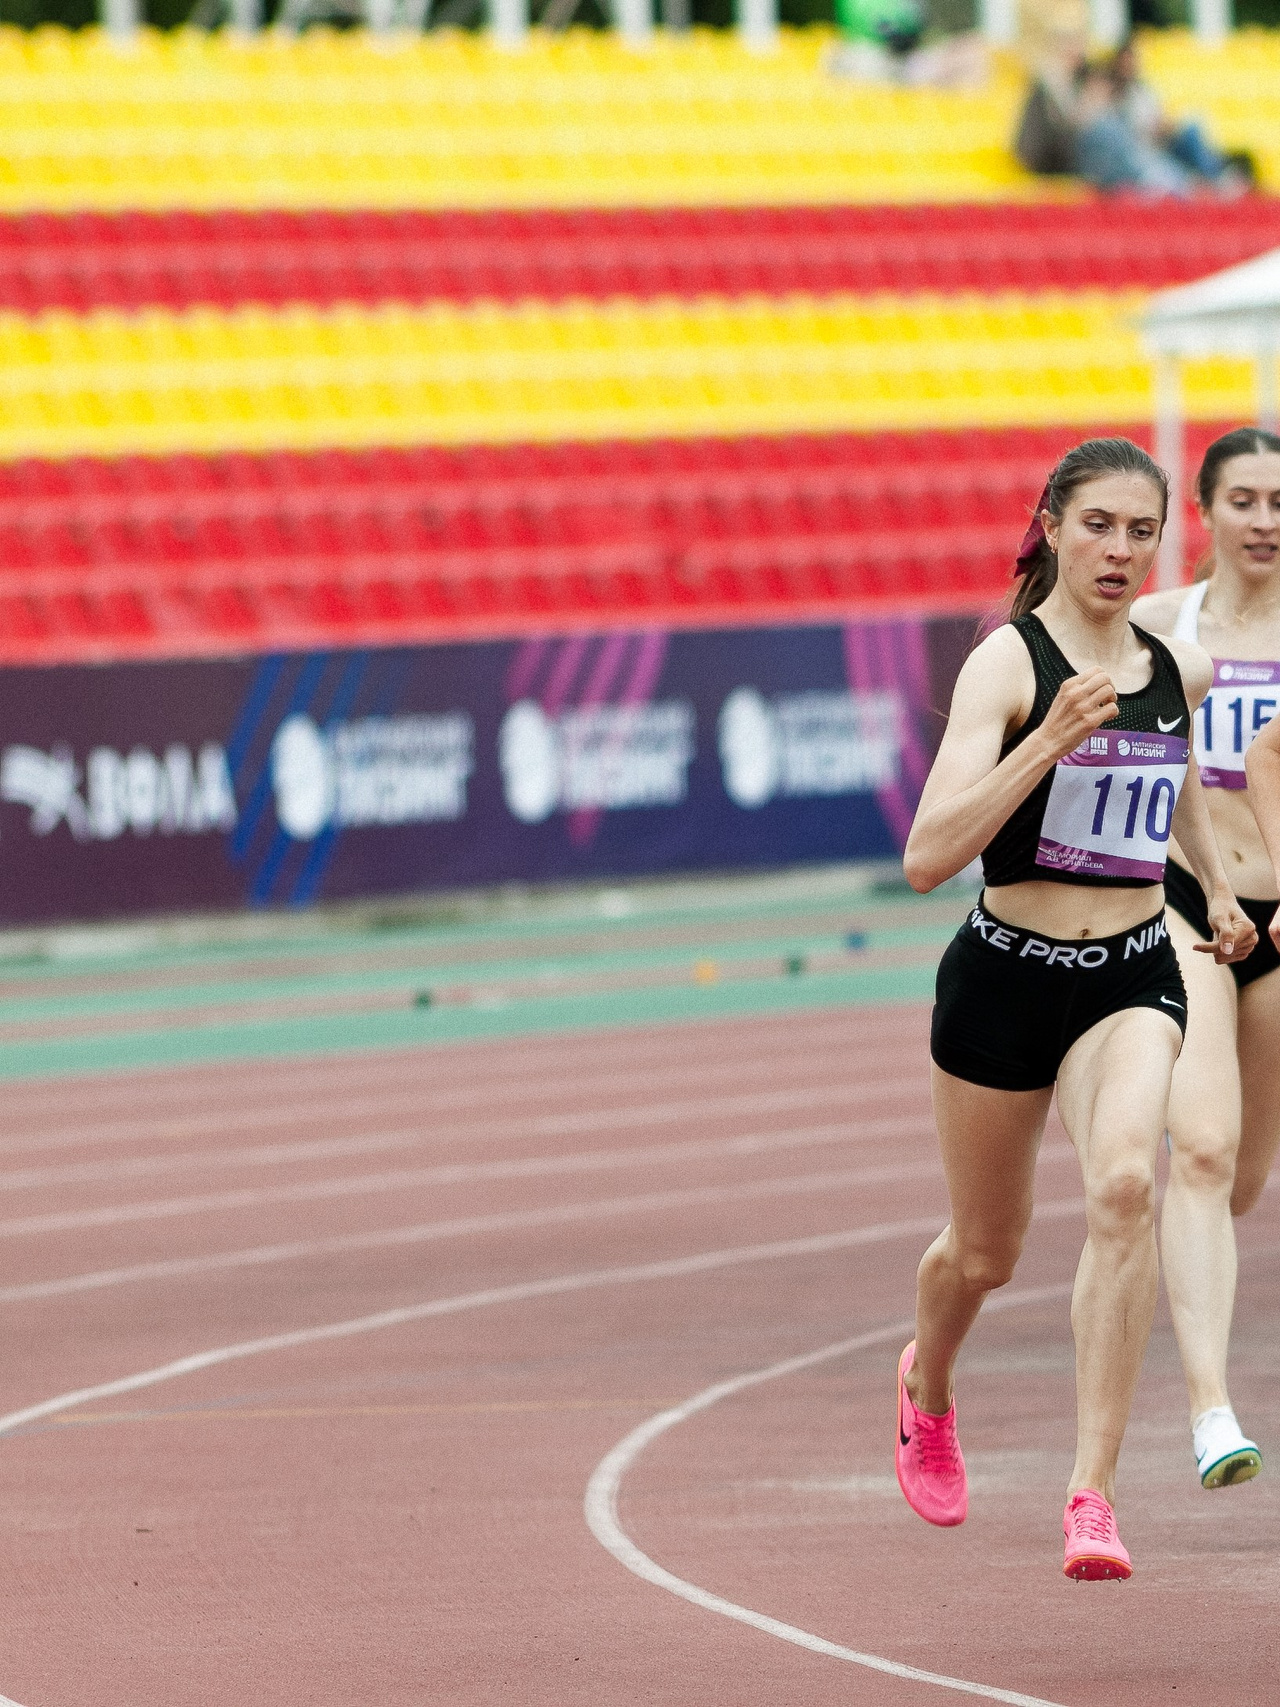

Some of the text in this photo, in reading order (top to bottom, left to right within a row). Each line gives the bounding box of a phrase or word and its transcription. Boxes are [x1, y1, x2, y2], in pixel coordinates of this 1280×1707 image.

[1131, 741, 1167, 750] БАЛТИЙСКИЙ
[1131, 747, 1167, 758] ЛИЗИНГ
[1091, 774, 1175, 842] 110
[1019, 938, 1109, 969] PRO
